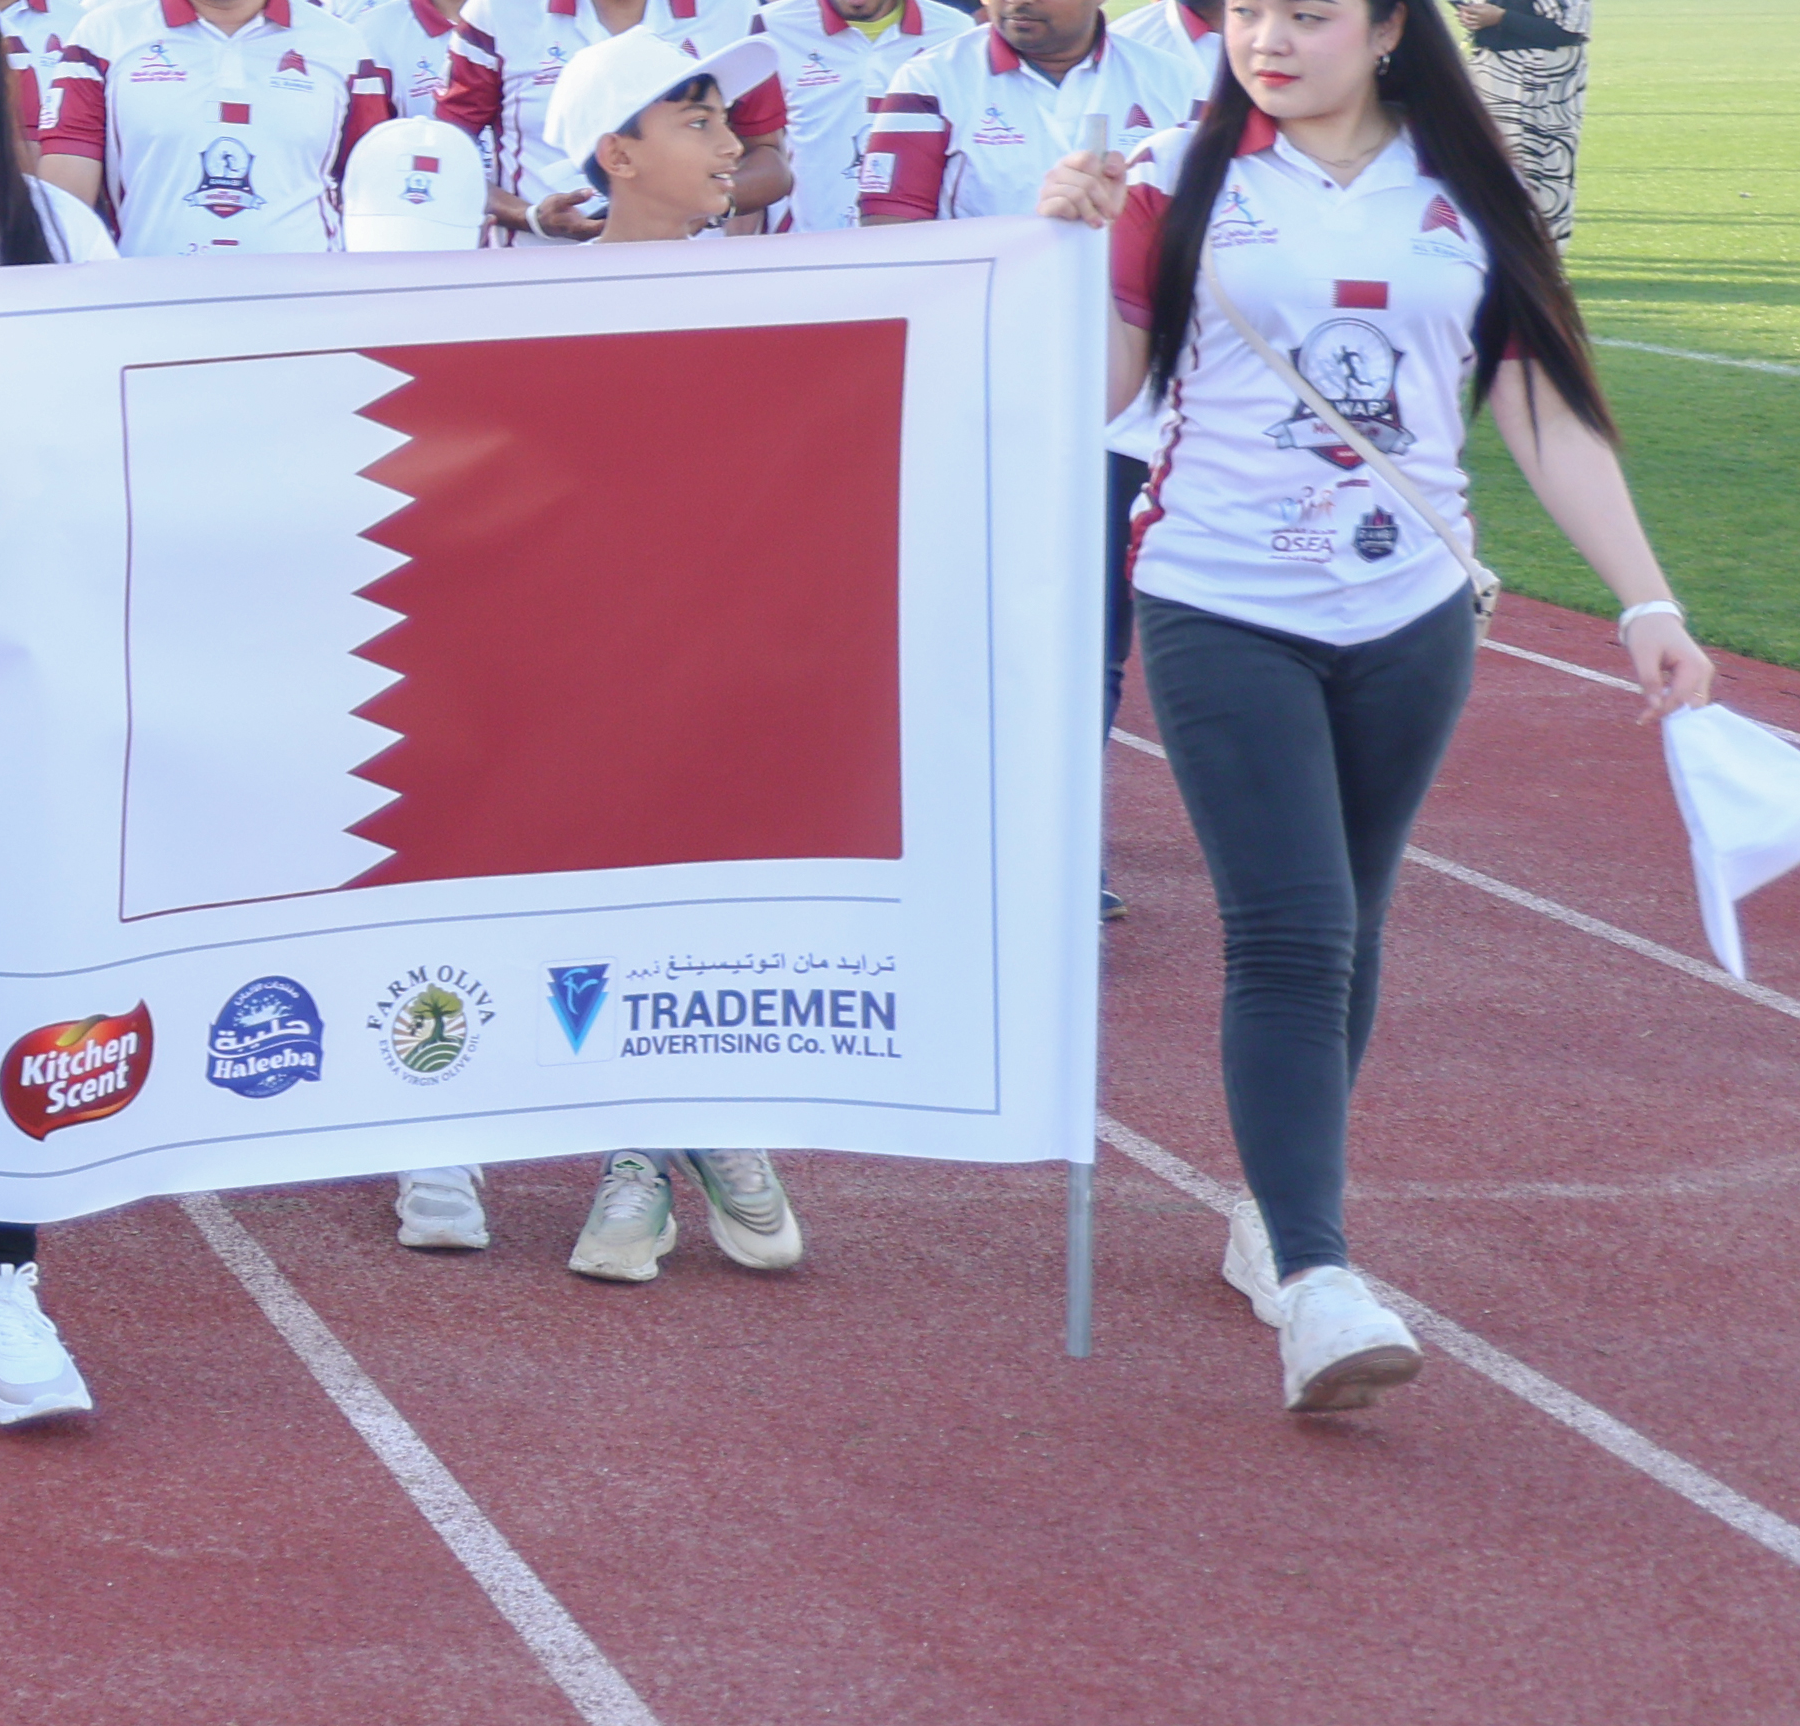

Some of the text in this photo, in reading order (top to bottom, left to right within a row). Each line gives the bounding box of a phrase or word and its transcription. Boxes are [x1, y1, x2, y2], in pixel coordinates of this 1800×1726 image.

[366, 964, 497, 1031] FARM OLIVA
[622, 988, 897, 1031] TRADEMEN
[19, 1025, 139, 1088] Kitchen
[212, 1048, 316, 1079] Haleeba
[620, 1033, 781, 1058] ADVERTISING
[787, 1034, 826, 1055] Co.
[44, 1060, 129, 1115] Scent
